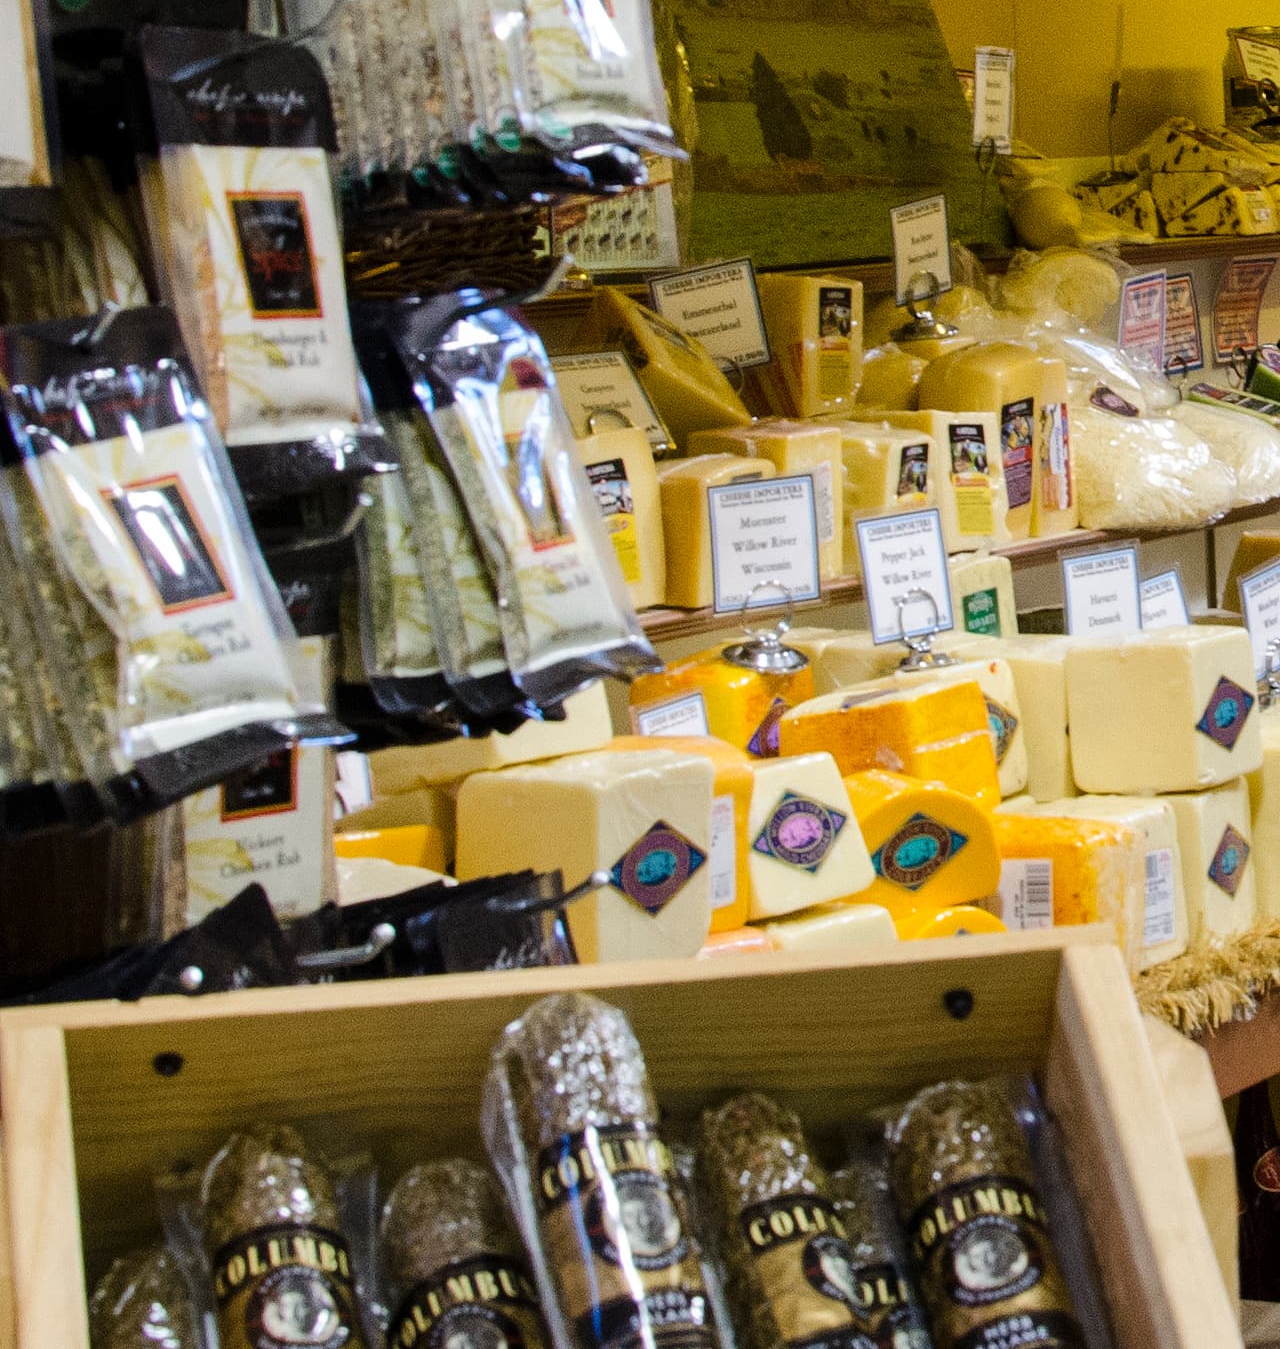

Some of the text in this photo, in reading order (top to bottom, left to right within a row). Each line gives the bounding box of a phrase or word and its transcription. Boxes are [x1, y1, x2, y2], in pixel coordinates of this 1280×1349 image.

[662, 278, 693, 292] CHEESE
[695, 268, 743, 284] IMPORTERS
[686, 316, 742, 337] witzerland
[719, 489, 752, 502] CHEESE
[753, 484, 804, 500] IMPORTERS
[739, 514, 788, 530] Muenster
[866, 518, 933, 538] CHEESE IMPORTERS
[732, 535, 799, 554] Willow River
[881, 545, 927, 565] Pepper Jack
[1095, 556, 1130, 569] IMPORTERS
[741, 559, 793, 576] Wisconsin
[881, 568, 933, 586] Willow River
[1090, 591, 1118, 605] Havarti
[1088, 612, 1122, 629] Denmark
[278, 849, 301, 868] Rub
[542, 1139, 674, 1199] COLUM
[921, 1187, 1036, 1246] OLUMBU
[215, 1236, 350, 1297] COLUMBU
[401, 1268, 518, 1347] OLUMBU
